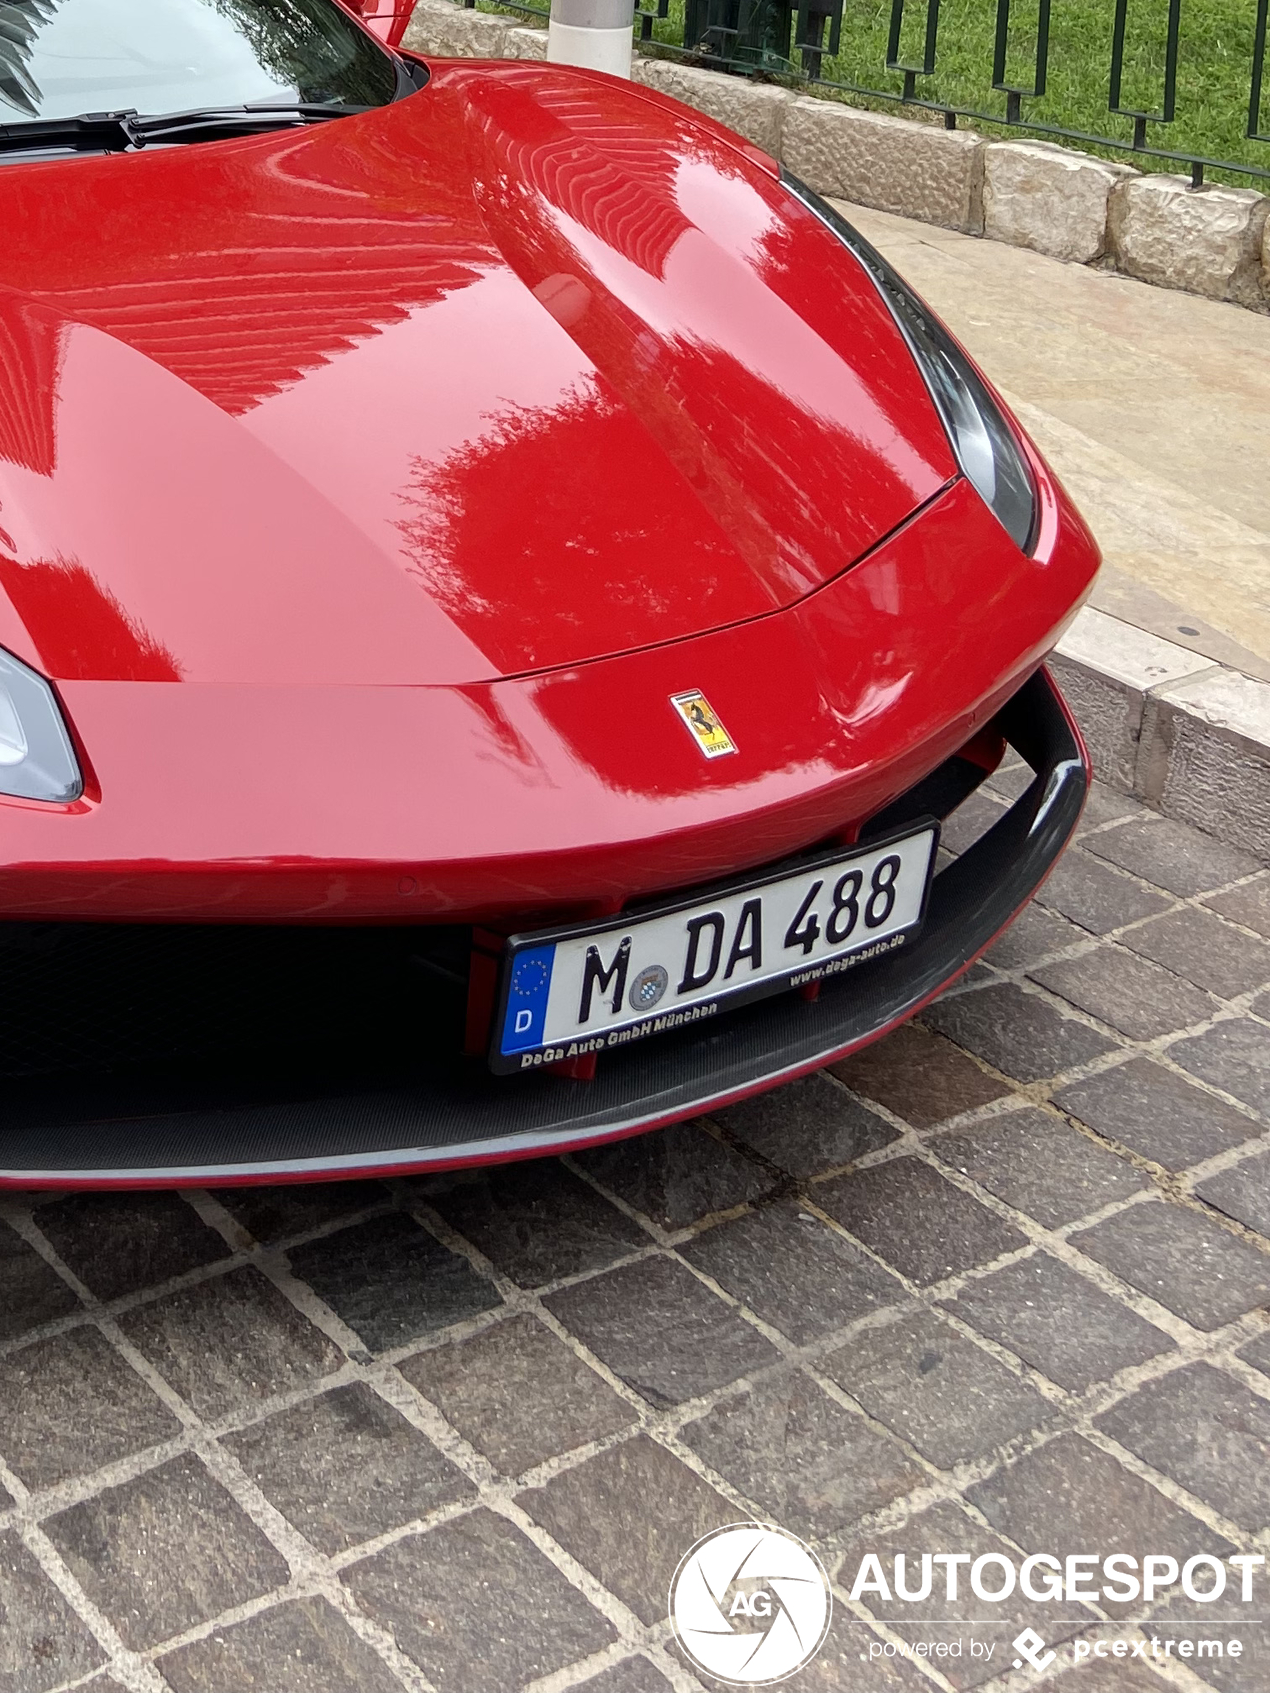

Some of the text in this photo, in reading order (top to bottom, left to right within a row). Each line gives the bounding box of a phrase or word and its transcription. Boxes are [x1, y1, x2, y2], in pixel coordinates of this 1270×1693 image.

[578, 935, 632, 1024] M
[677, 897, 762, 995] DA
[783, 854, 901, 956] 488
[790, 934, 906, 987] www.dega-auto.de
[515, 1009, 533, 1034] D
[566, 1037, 605, 1058] Auto
[608, 1020, 652, 1046] GmbH
[653, 1003, 717, 1032] München
